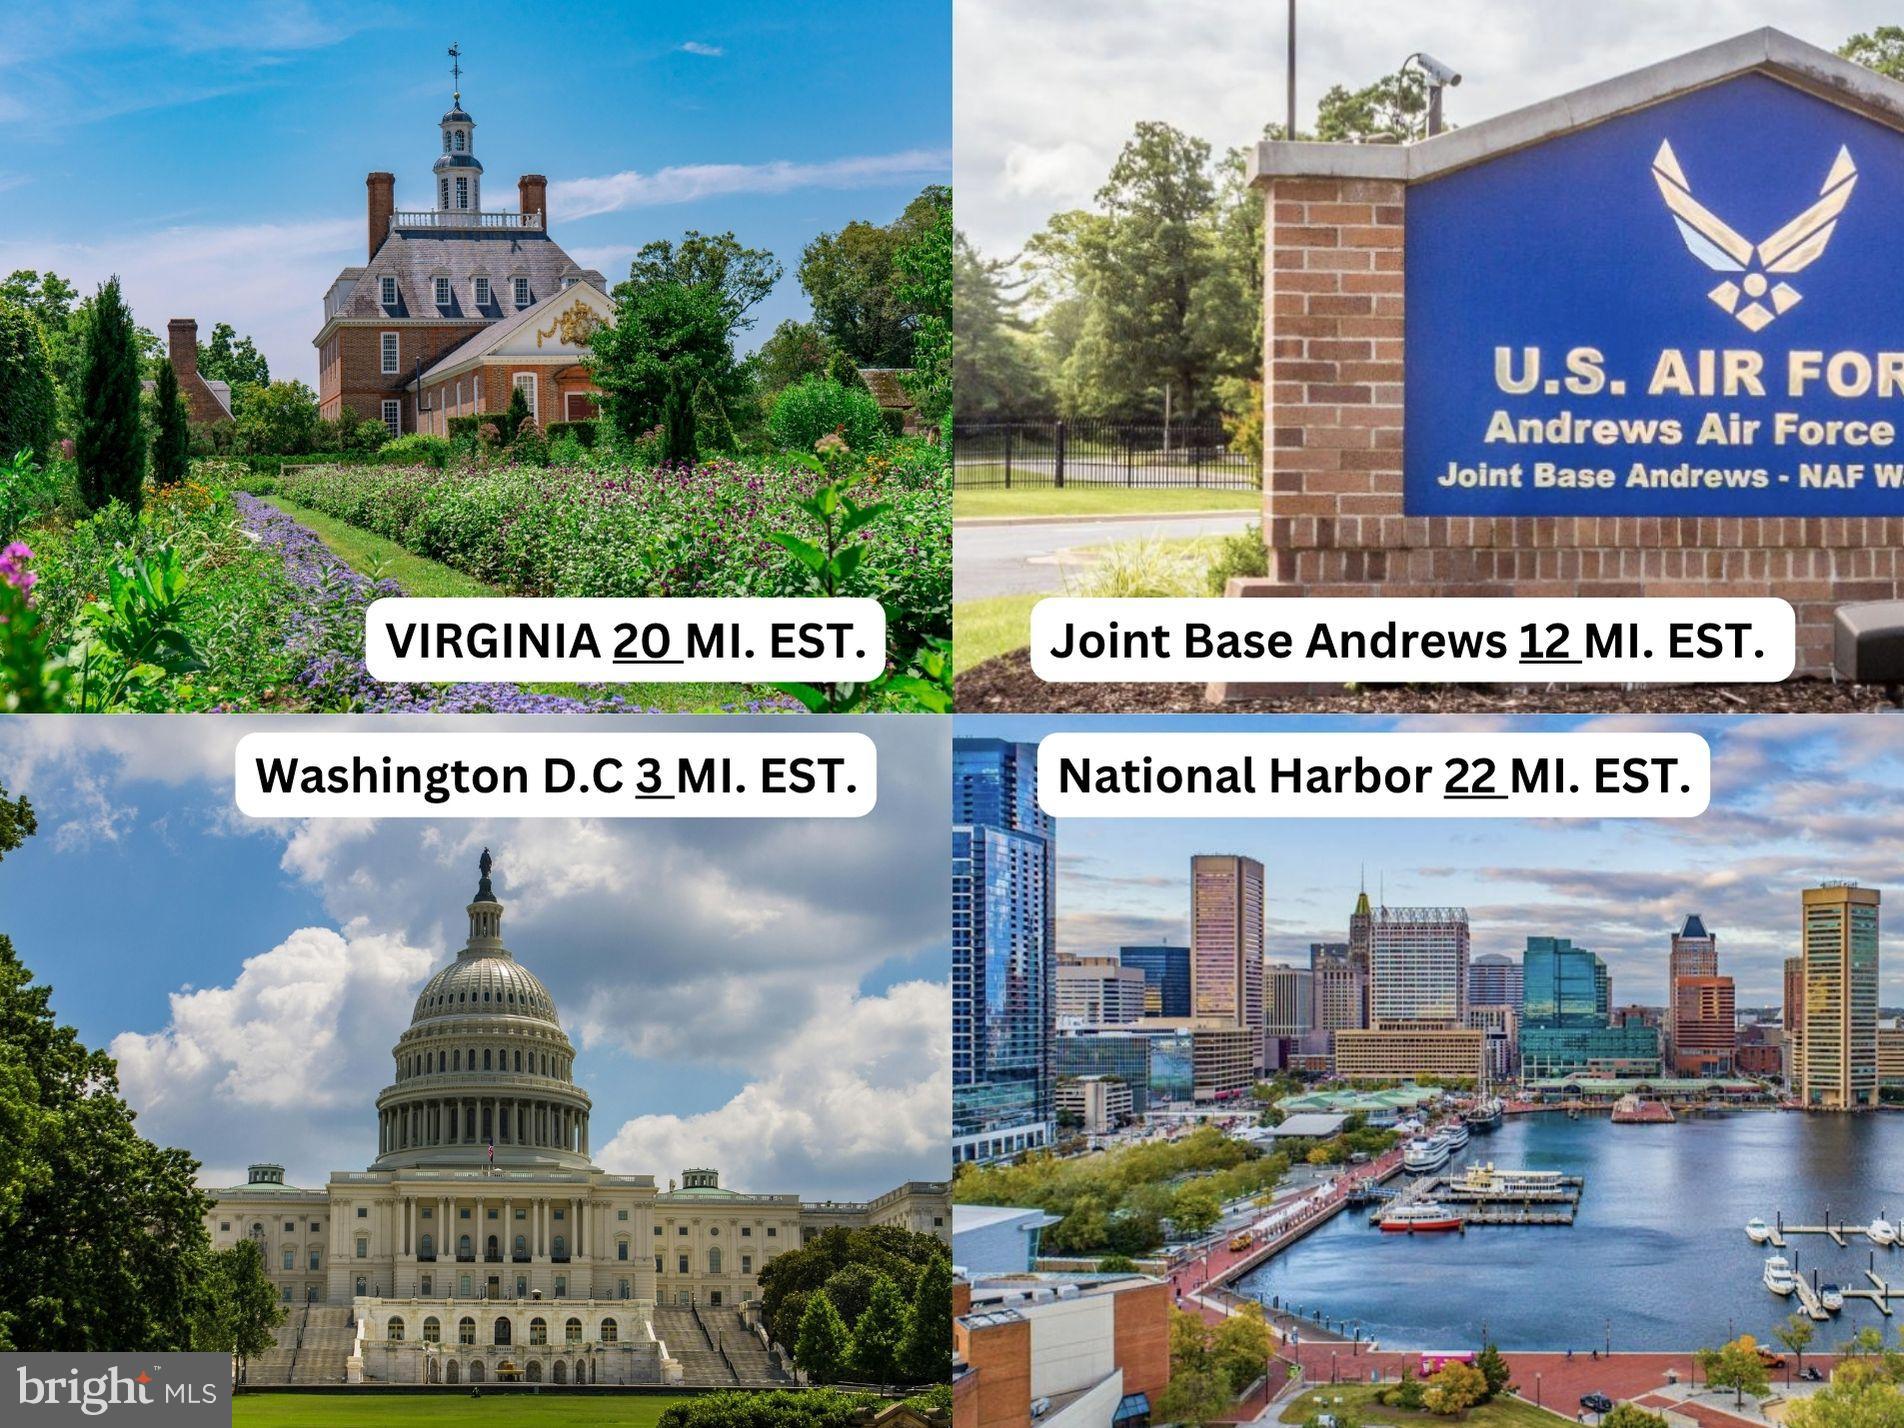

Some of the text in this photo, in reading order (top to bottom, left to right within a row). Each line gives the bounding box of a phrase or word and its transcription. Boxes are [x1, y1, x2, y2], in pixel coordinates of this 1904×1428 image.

[1494, 346, 1626, 395] U.S.
[1648, 349, 1766, 397] AIR
[1484, 410, 1895, 447] Andrews Air Force
[1438, 461, 1523, 489] Joint
[1534, 462, 1616, 489] Base
[1626, 463, 1769, 489] Andrews
[1799, 463, 1865, 488] NAF
[1874, 463, 1904, 489] W
